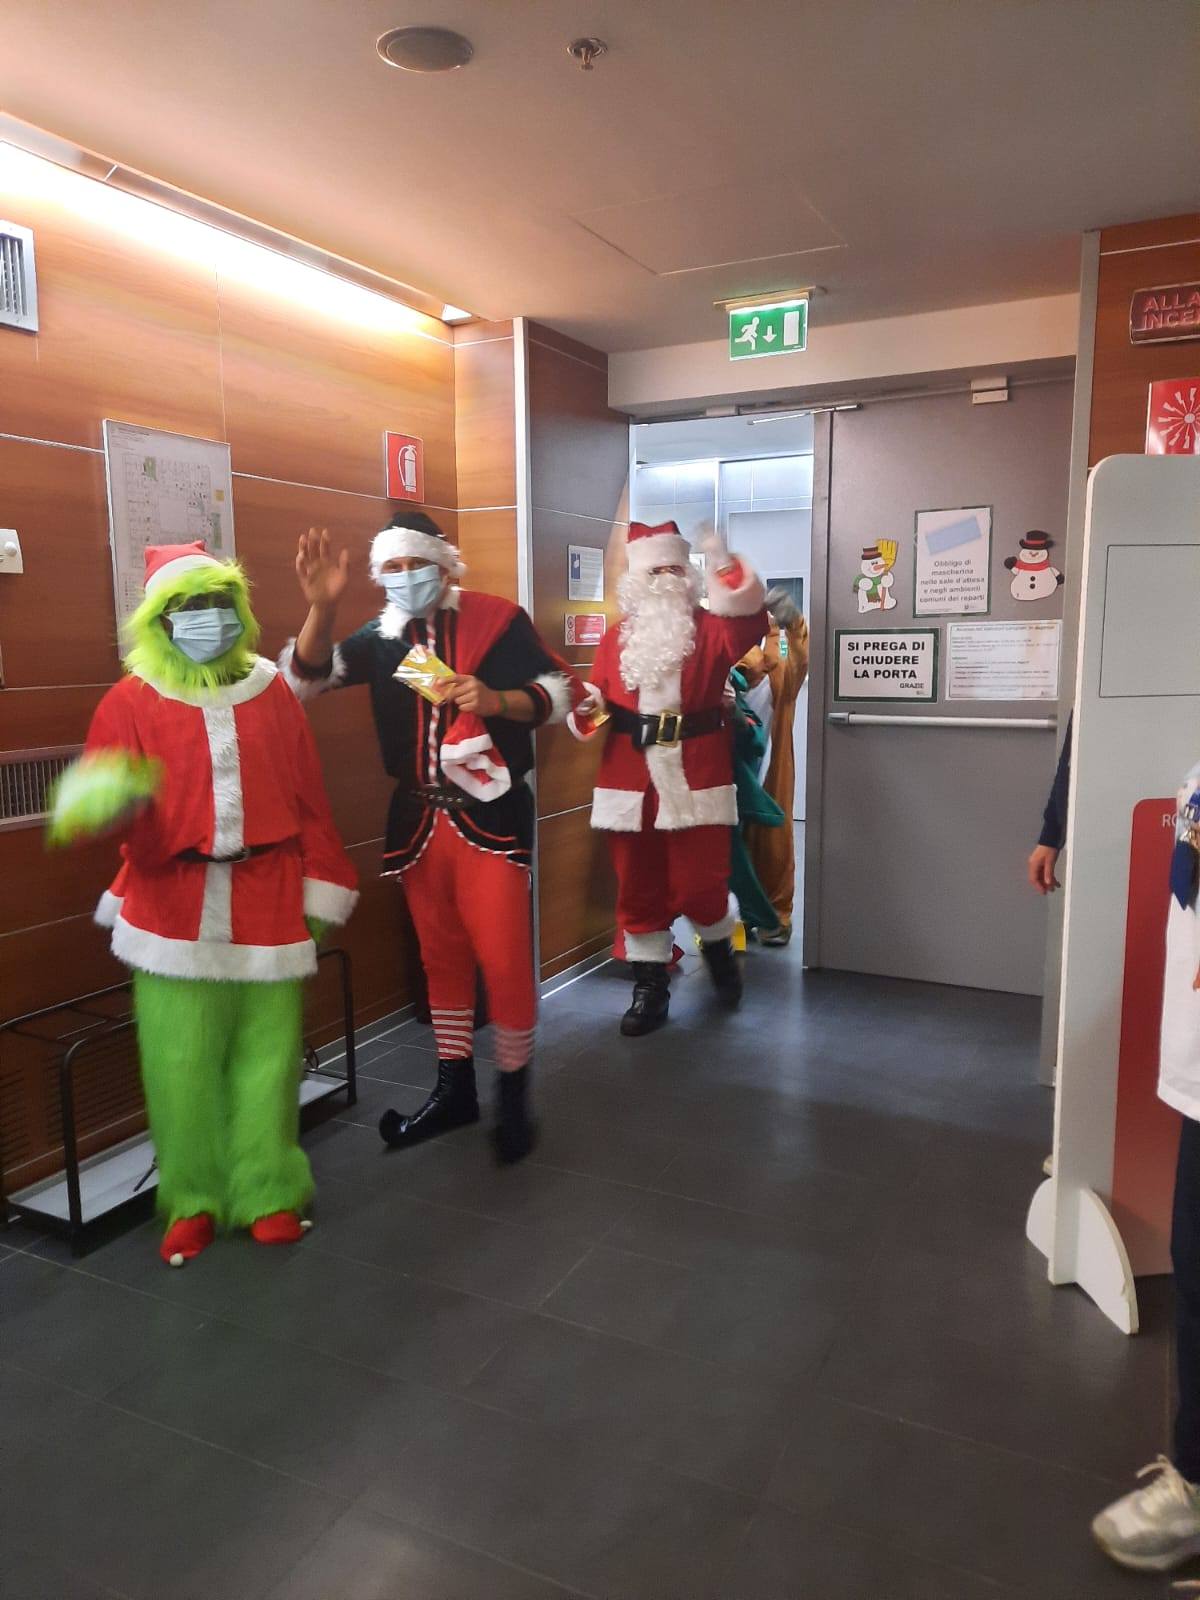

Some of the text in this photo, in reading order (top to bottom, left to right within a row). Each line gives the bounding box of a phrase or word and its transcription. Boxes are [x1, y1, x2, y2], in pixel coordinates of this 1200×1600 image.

[1143, 309, 1200, 329] INCE
[934, 559, 963, 568] Obbligo
[931, 568, 974, 576] mascherina
[930, 586, 948, 595] negli
[948, 585, 981, 593] ambienti
[960, 594, 985, 602] reparti
[847, 641, 925, 651] SI PREGA DI
[852, 655, 919, 665] CHIUDERE
[853, 669, 917, 679] LA PORTA
